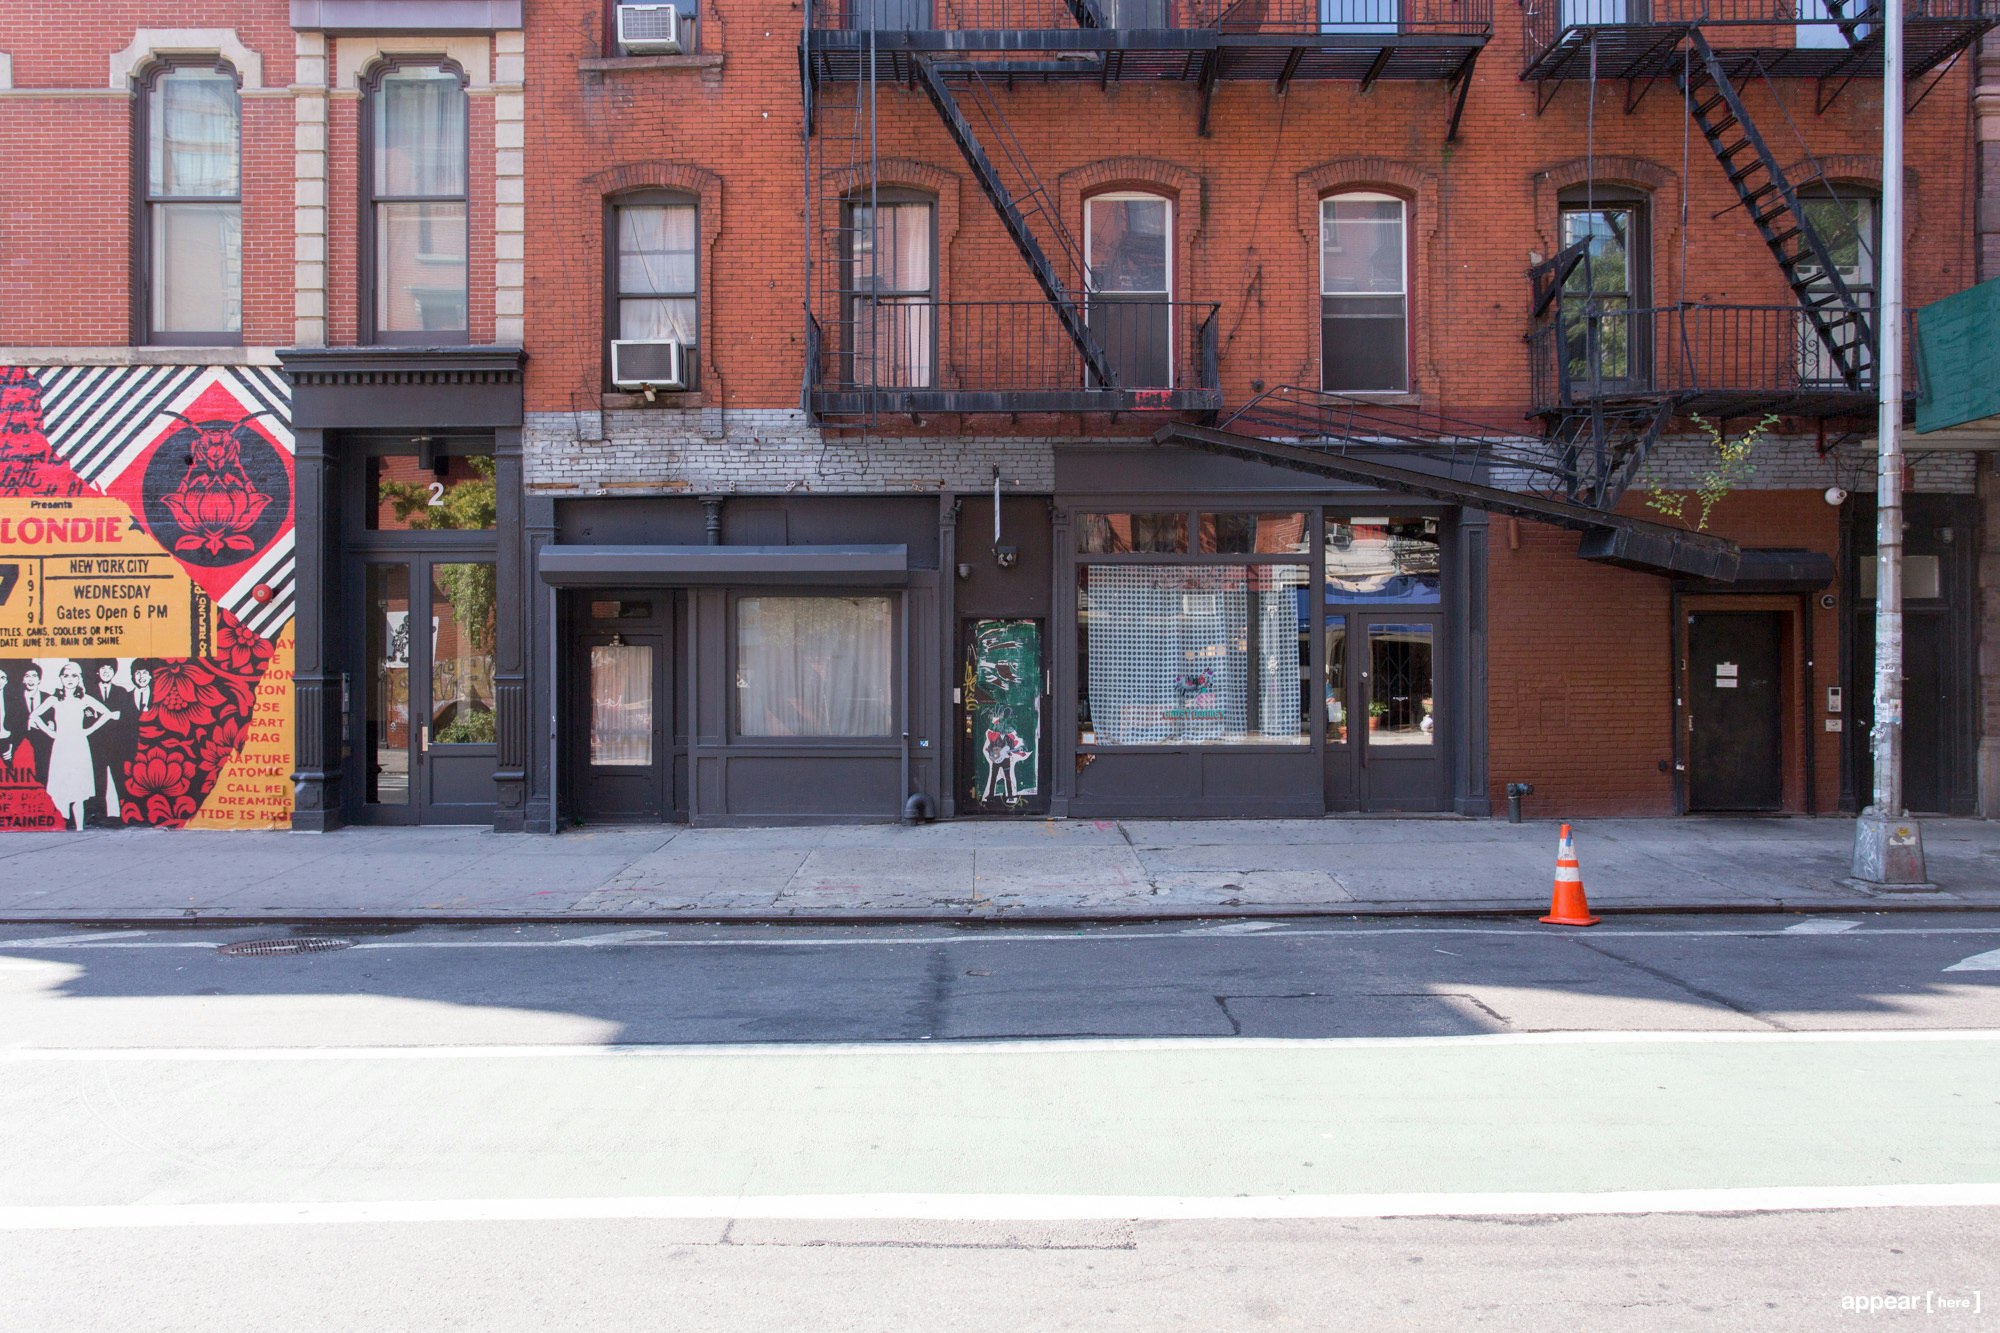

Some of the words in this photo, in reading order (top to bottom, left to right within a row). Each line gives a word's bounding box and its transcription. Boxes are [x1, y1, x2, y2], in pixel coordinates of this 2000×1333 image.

[428, 482, 444, 506] 2
[31, 500, 73, 509] Presents
[70, 560, 94, 573] NEW
[96, 560, 125, 573] YORK
[127, 560, 149, 573] CITY
[74, 585, 151, 599] WEDNESDAY
[57, 605, 91, 620] Gates
[96, 605, 128, 621] Open
[133, 605, 141, 619] 6
[147, 605, 168, 619] PM
[53, 626, 87, 636] COOLERS
[90, 626, 101, 635] OR
[0, 638, 18, 648] DATE
[22, 637, 41, 647] JUNE
[60, 637, 80, 646] RAIN
[82, 636, 94, 646] OR
[246, 733, 280, 742] RAG
[226, 754, 290, 764] RAPTURE
[228, 767, 284, 777] ATOMIC
[227, 783, 260, 793] CALL
[265, 785, 281, 793] ME
[218, 796, 292, 806] DREAMING
[200, 808, 235, 819] TIDE
[239, 810, 255, 820] IS
[260, 811, 293, 821] HIG
[0, 815, 55, 827] ETAINED
